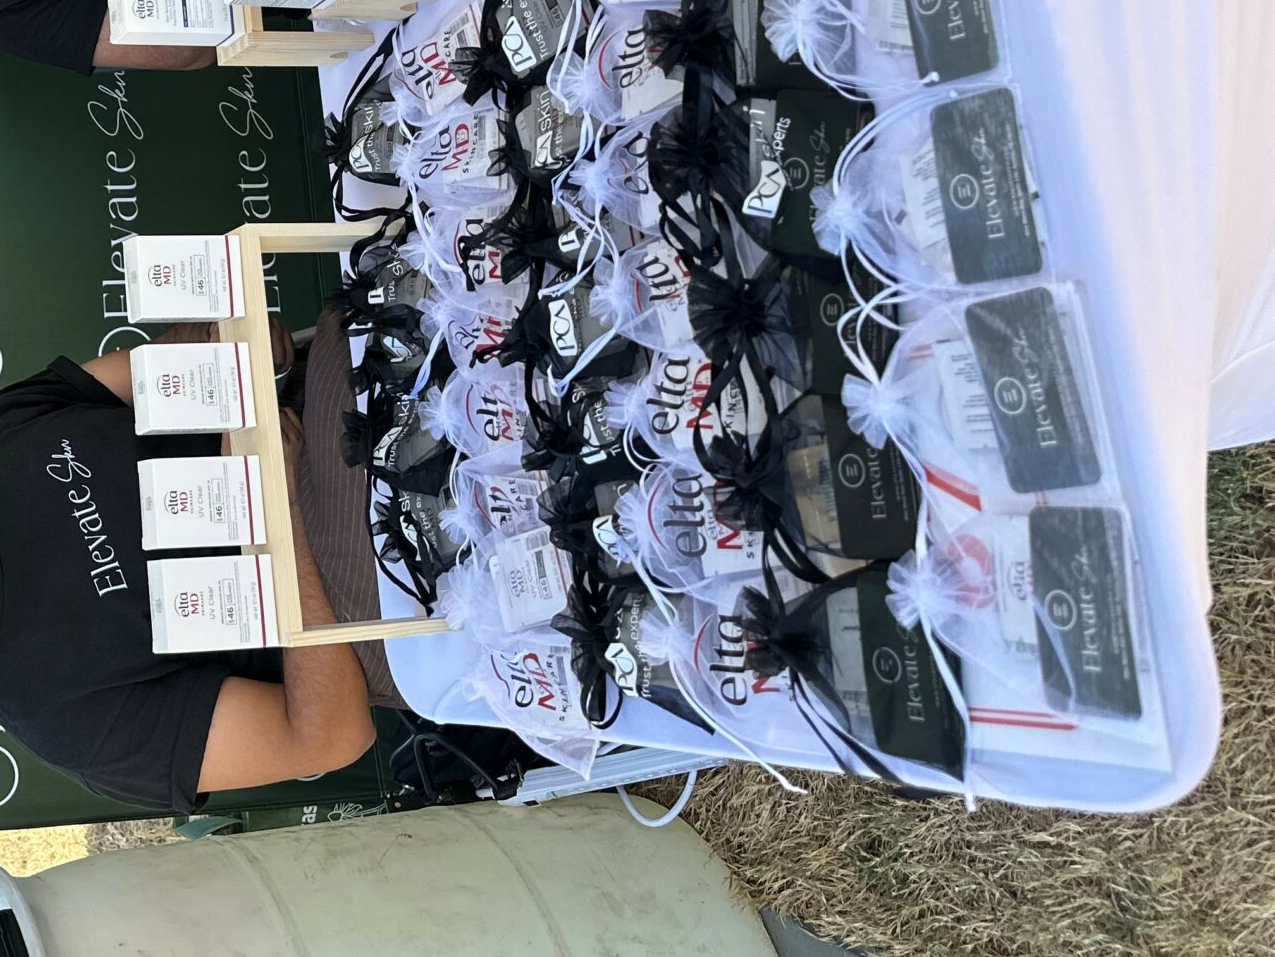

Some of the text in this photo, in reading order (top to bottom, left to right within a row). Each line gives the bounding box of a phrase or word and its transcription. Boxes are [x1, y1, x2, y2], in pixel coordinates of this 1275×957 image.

[136, 0, 146, 19] elta
[147, 1, 154, 17] MD
[505, 20, 530, 64] PCA
[527, 10, 549, 59] Trust the
[420, 42, 456, 85] MD
[612, 28, 645, 88] elta
[536, 92, 551, 131] skin
[441, 123, 469, 171] MD
[746, 167, 781, 213] PCA
[979, 164, 1005, 238] Elevate
[151, 264, 163, 287] elta
[163, 266, 171, 284] MD
[553, 311, 573, 351] PCA
[160, 374, 172, 397] elta
[172, 375, 181, 395] MD
[646, 357, 690, 435] elta
[168, 490, 178, 515] elta
[180, 492, 188, 512] MD
[865, 447, 887, 519] Elevate
[663, 473, 707, 556] elta
[61, 485, 129, 598] Elevate
[178, 592, 189, 617] elta
[191, 593, 199, 614] MD
[1079, 585, 1103, 673] Elevate
[709, 614, 748, 706] elta
